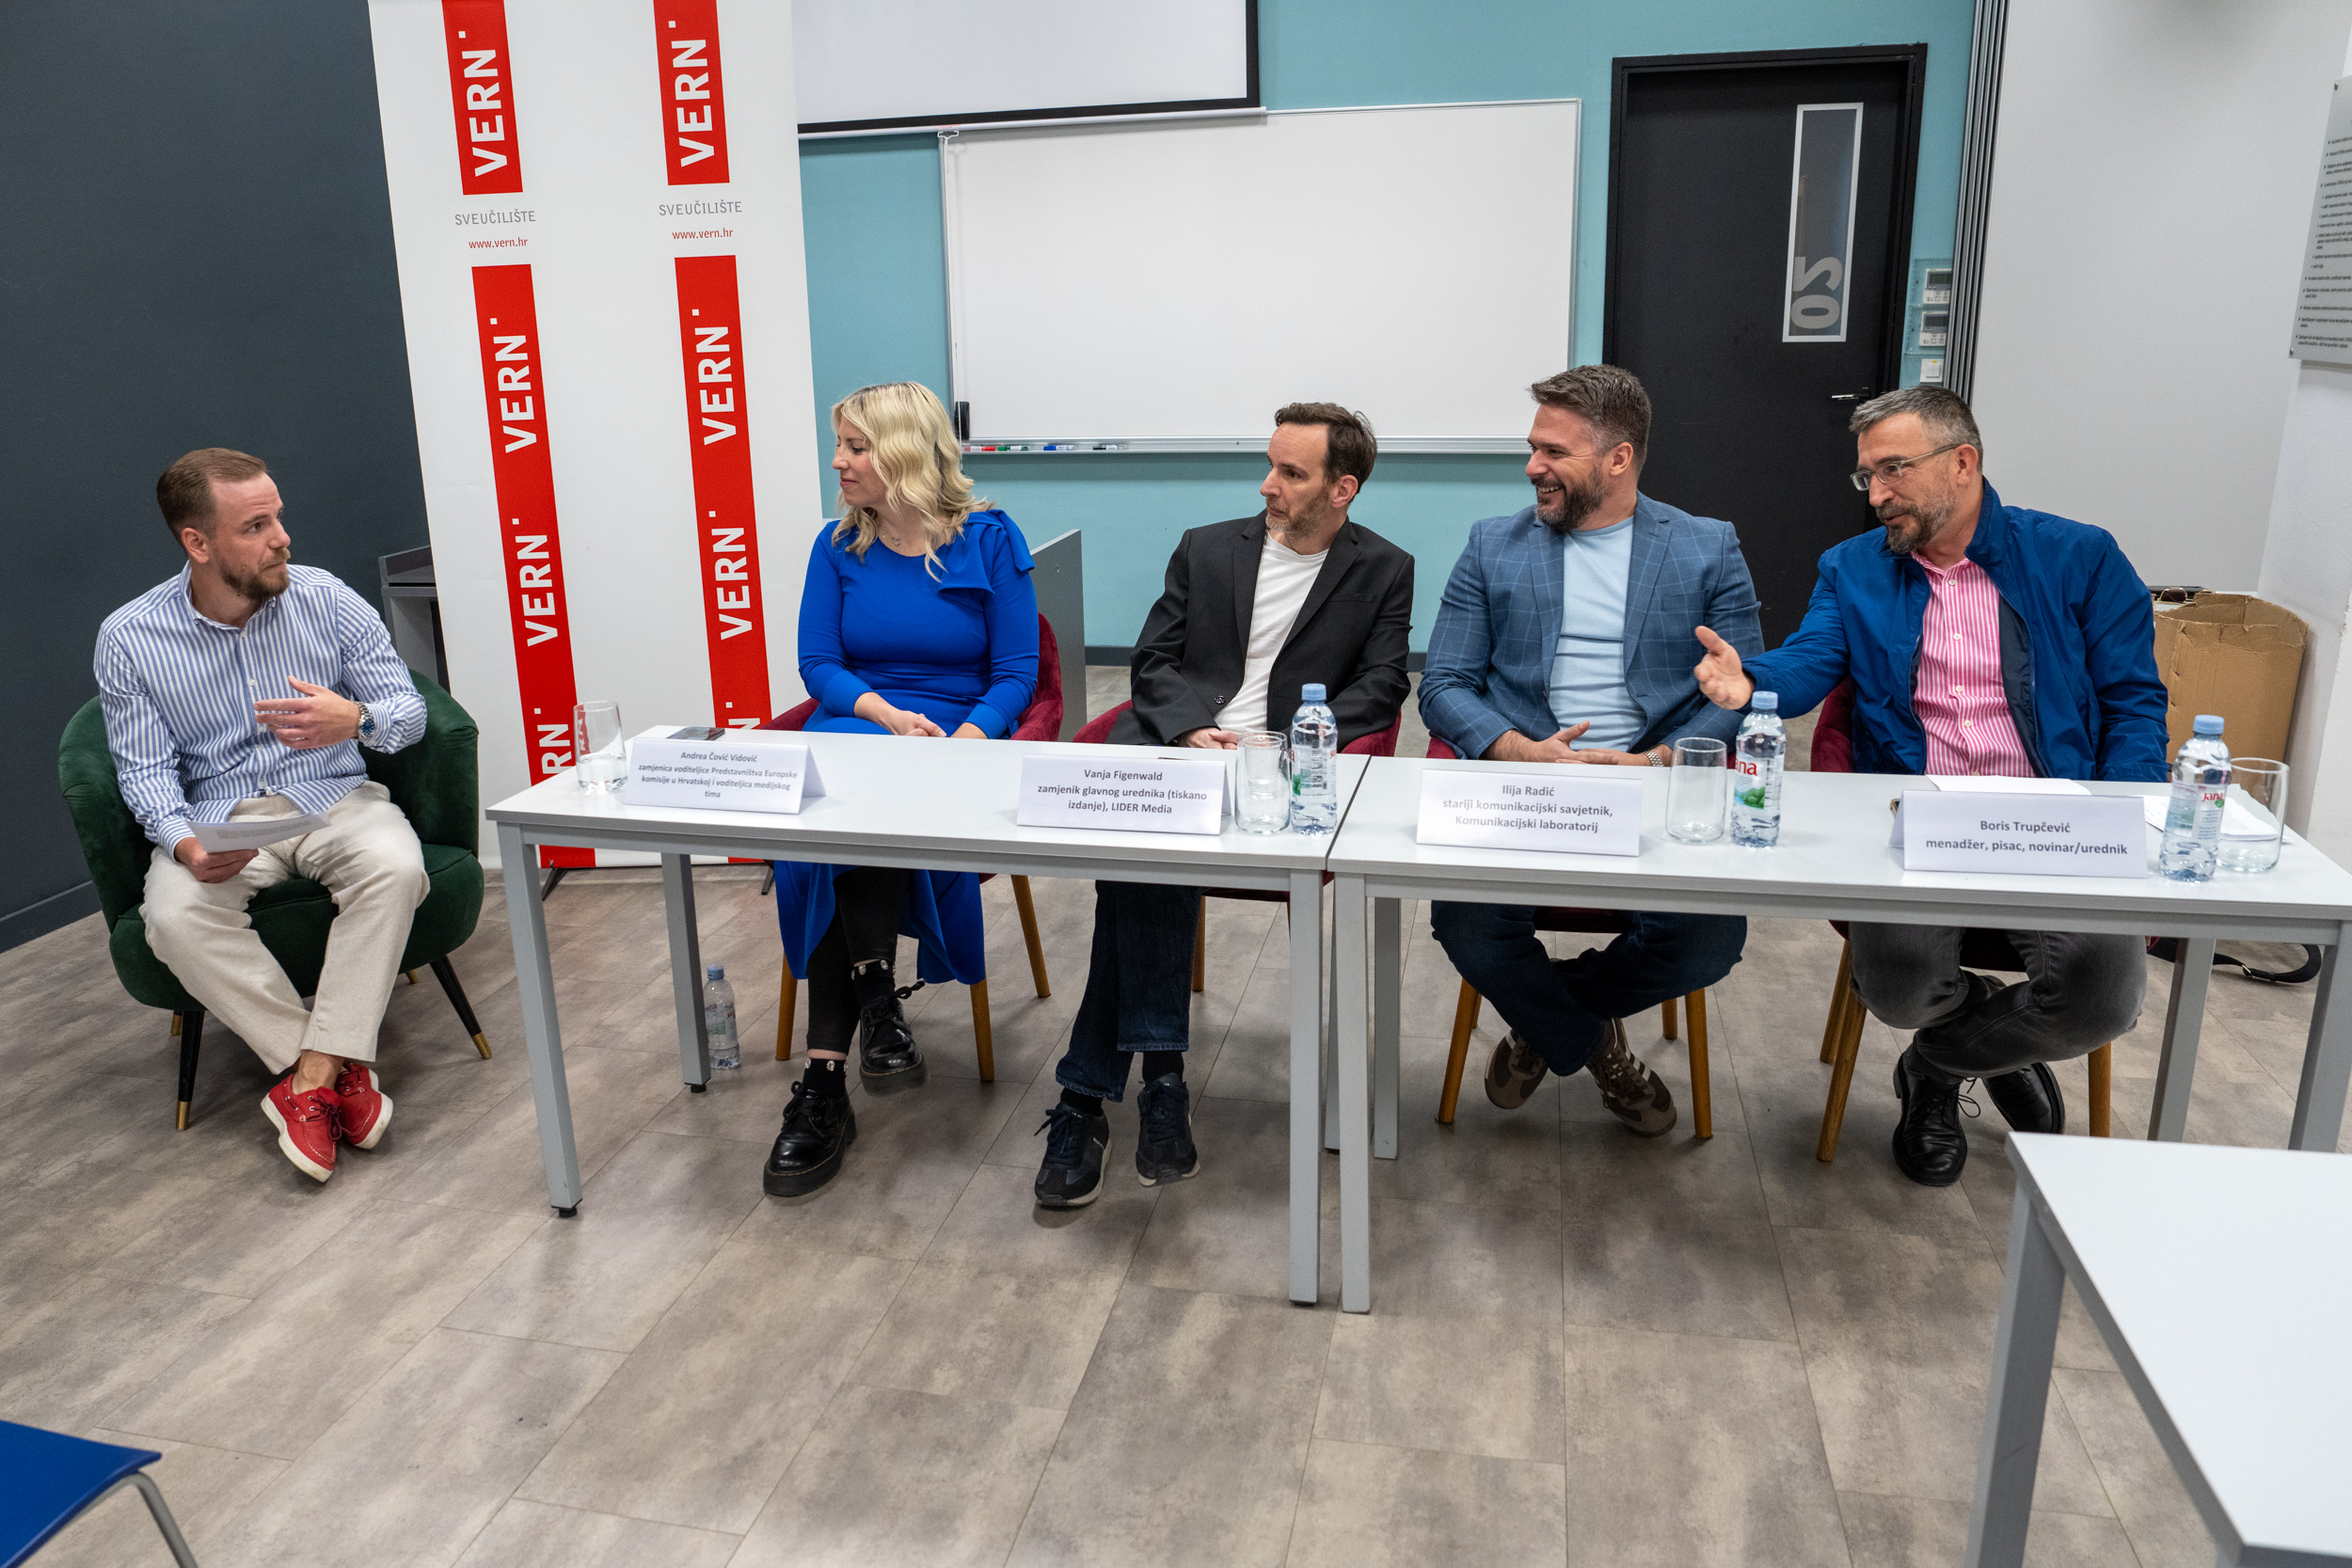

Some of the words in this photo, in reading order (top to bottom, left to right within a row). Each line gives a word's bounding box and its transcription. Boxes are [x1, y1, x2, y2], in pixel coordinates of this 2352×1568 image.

[659, 198, 742, 216] SVEUČILIŠTE
[454, 208, 536, 226] SVEUČILIŠTE
[672, 227, 734, 240] www.vern.hr
[468, 236, 528, 248] www.vern.hr
[537, 724, 572, 774] RN
[680, 752, 707, 760] Andrea
[708, 752, 729, 761] Čović
[730, 753, 757, 763] Vidović
[638, 764, 673, 772] zamjenica
[674, 766, 709, 775] voditeljice
[711, 767, 763, 777] Predstavništva
[764, 769, 798, 779] Europske
[1084, 769, 1111, 781] Vanja
[1113, 770, 1163, 782] Figenwald
[641, 775, 671, 784] komisije
[677, 777, 711, 786] Hrvatskoj
[716, 780, 753, 788] voditeljica
[754, 782, 791, 791] medijskog
[1502, 784, 1521, 797] Ilija
[1525, 786, 1555, 797] Radić
[1038, 784, 1080, 796] zamjenik
[1082, 785, 1120, 798] glavnog
[1122, 788, 1165, 799] urednika
[1168, 789, 1207, 800] (tiskano
[1068, 800, 1109, 813] izdanje),
[1111, 802, 1138, 812] LIDER
[1141, 804, 1172, 814] Media
[1442, 799, 1473, 811] stariji
[1476, 800, 1557, 815] komunikacijski
[1560, 804, 1613, 817] savjetnik,
[1455, 816, 1536, 830] Komunikacijski
[1539, 819, 1598, 833] laboratorij
[1980, 820, 2010, 831] Boris
[2013, 821, 2071, 834] Trupčević
[1926, 838, 1988, 851] menadžer,
[1992, 840, 2026, 852] pisac,
[2028, 842, 2128, 855] novinar/urednik
